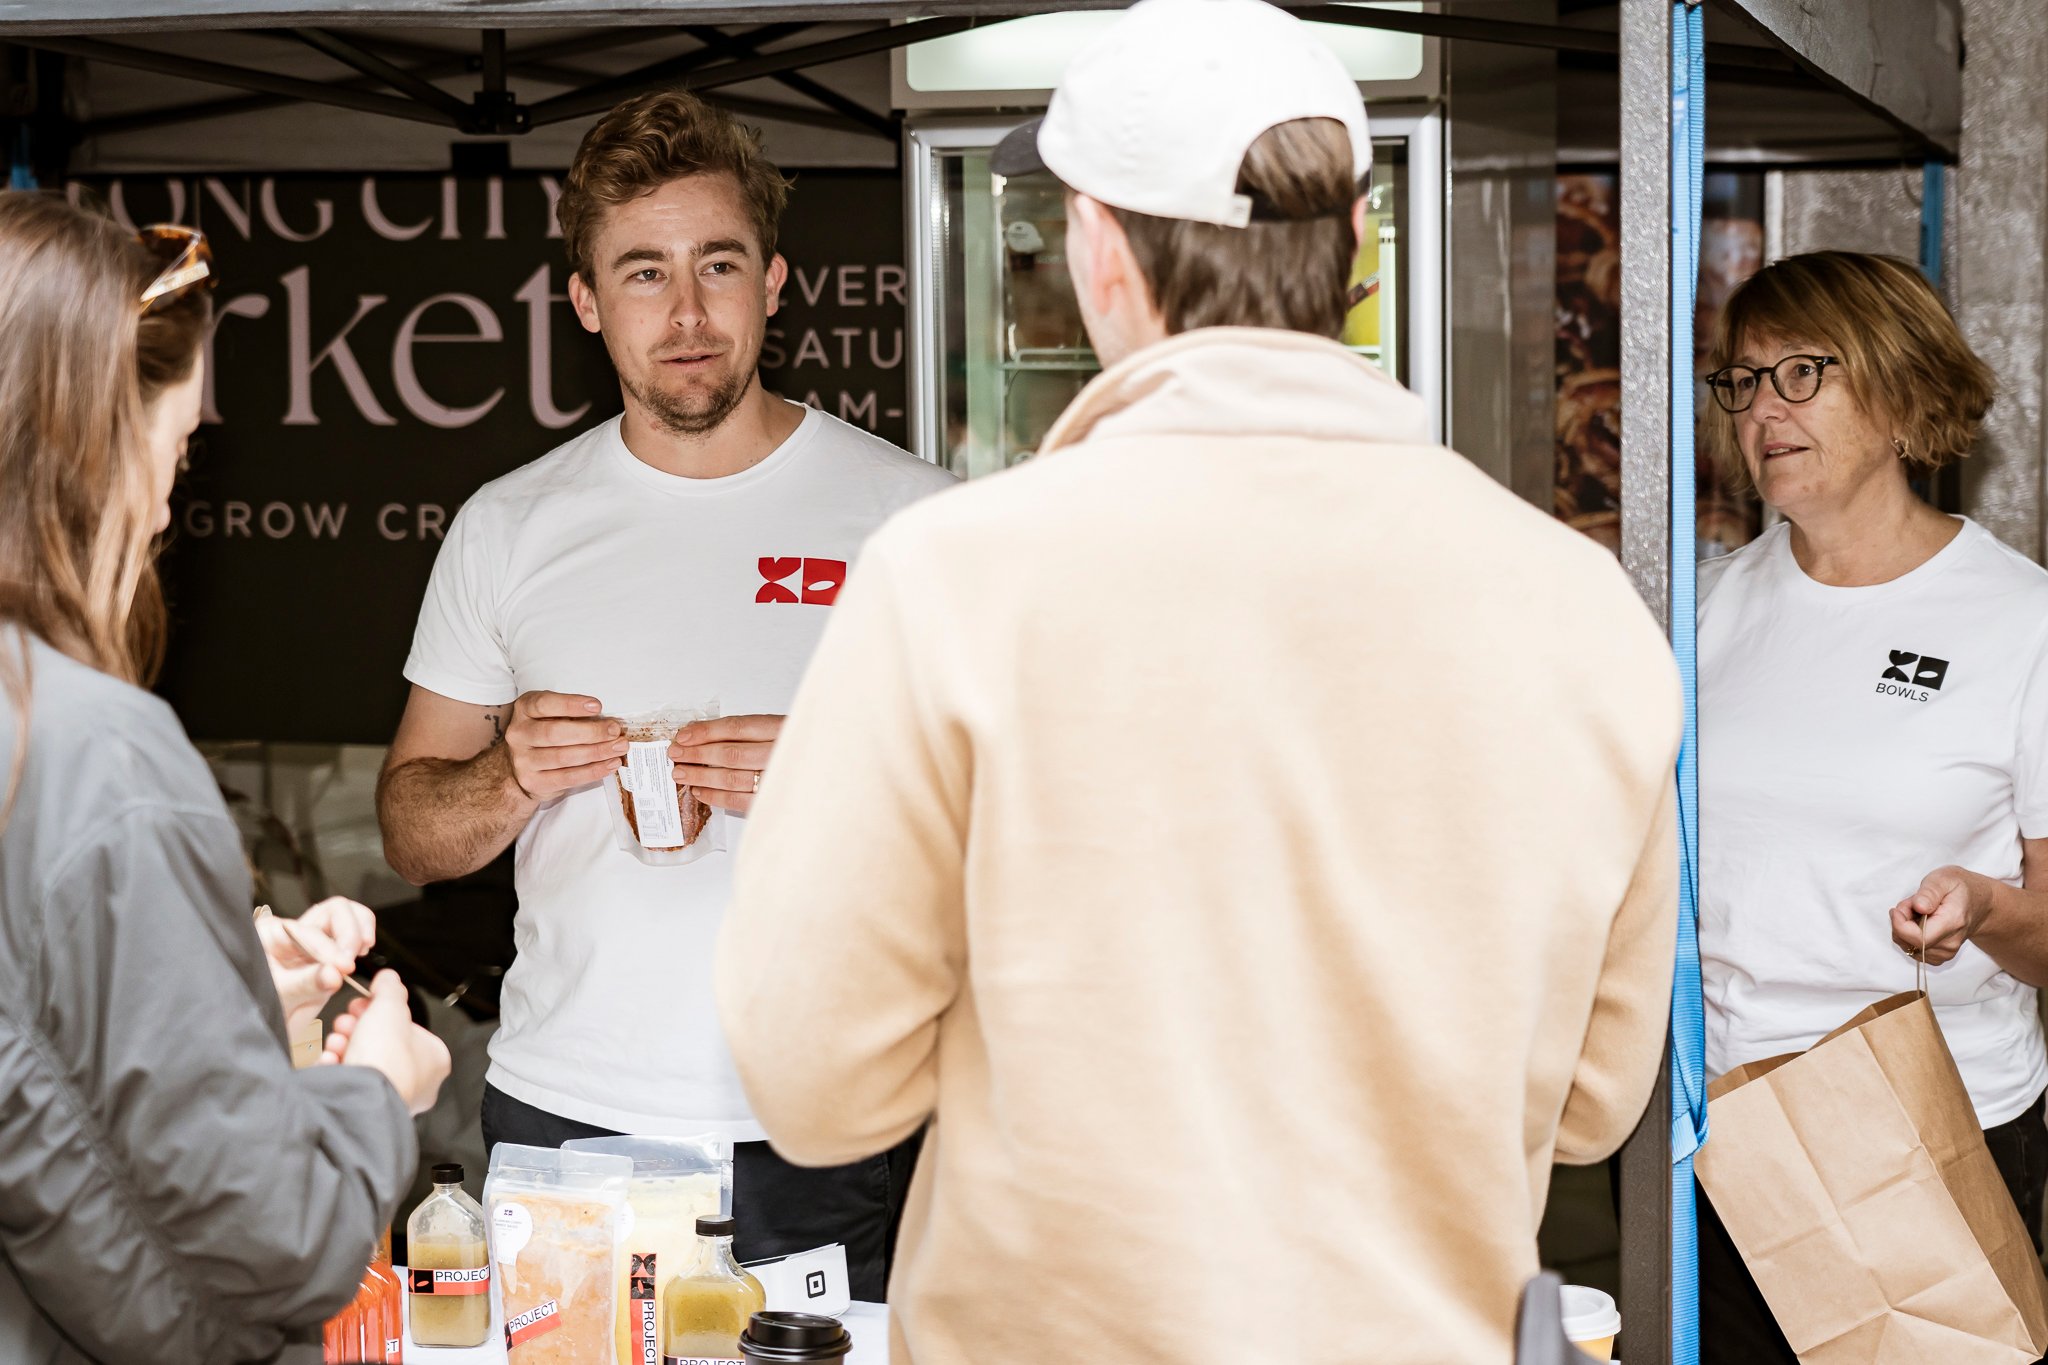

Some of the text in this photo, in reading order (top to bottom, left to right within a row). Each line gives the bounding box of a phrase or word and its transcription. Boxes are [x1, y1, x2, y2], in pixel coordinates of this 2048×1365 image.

[778, 264, 906, 307] VER
[759, 327, 904, 370] SATU
[183, 500, 465, 541] GROW CR
[1876, 682, 1929, 702] BOWLS
[509, 1301, 555, 1333] PROJECT
[643, 1301, 656, 1365] PROJECT
